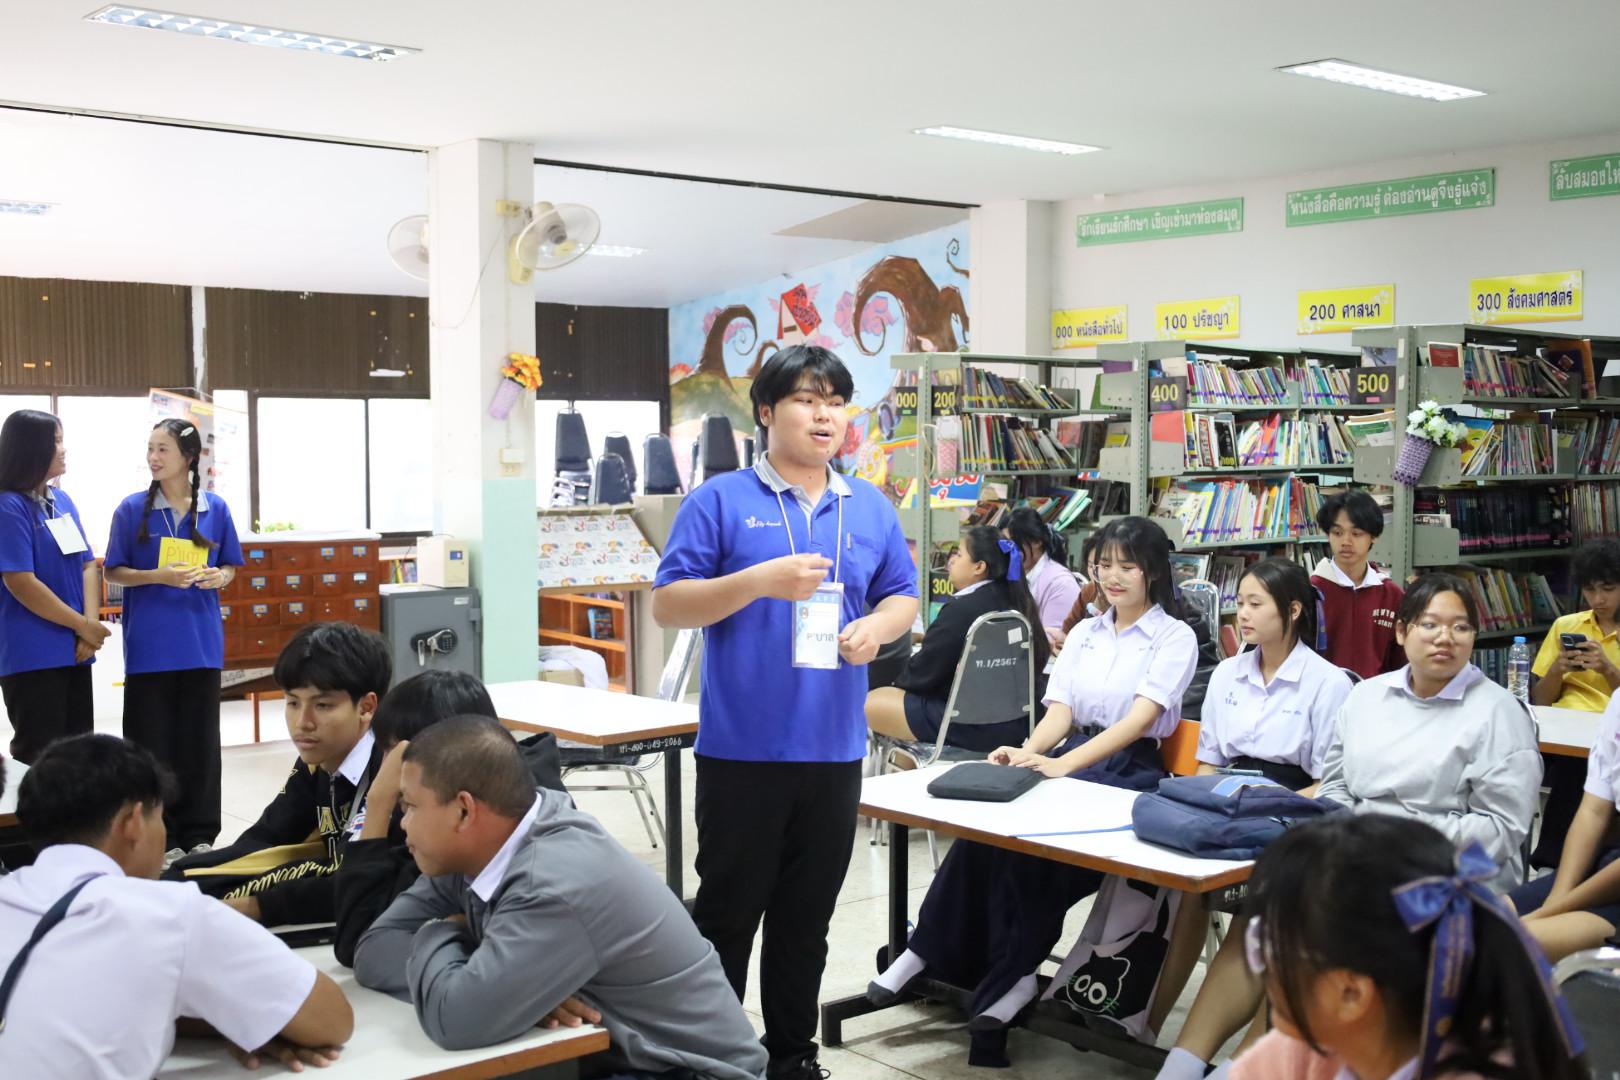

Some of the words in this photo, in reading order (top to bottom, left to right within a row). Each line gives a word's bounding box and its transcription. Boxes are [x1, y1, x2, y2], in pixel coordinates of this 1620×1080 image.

[1290, 187, 1382, 215] หนังสือคือความรู้
[1477, 292, 1501, 311] 300
[1507, 283, 1573, 309] สังคมศาสตร์
[1164, 314, 1187, 330] 100
[1193, 309, 1229, 329] ปรัชญา
[1309, 304, 1335, 321] 200
[1342, 302, 1380, 319] ศาสนา
[1055, 325, 1073, 339] 000
[1151, 383, 1179, 402] 400
[1357, 373, 1390, 394] 500
[896, 391, 917, 408] 000
[934, 391, 956, 408] 200
[932, 578, 954, 595] 300
